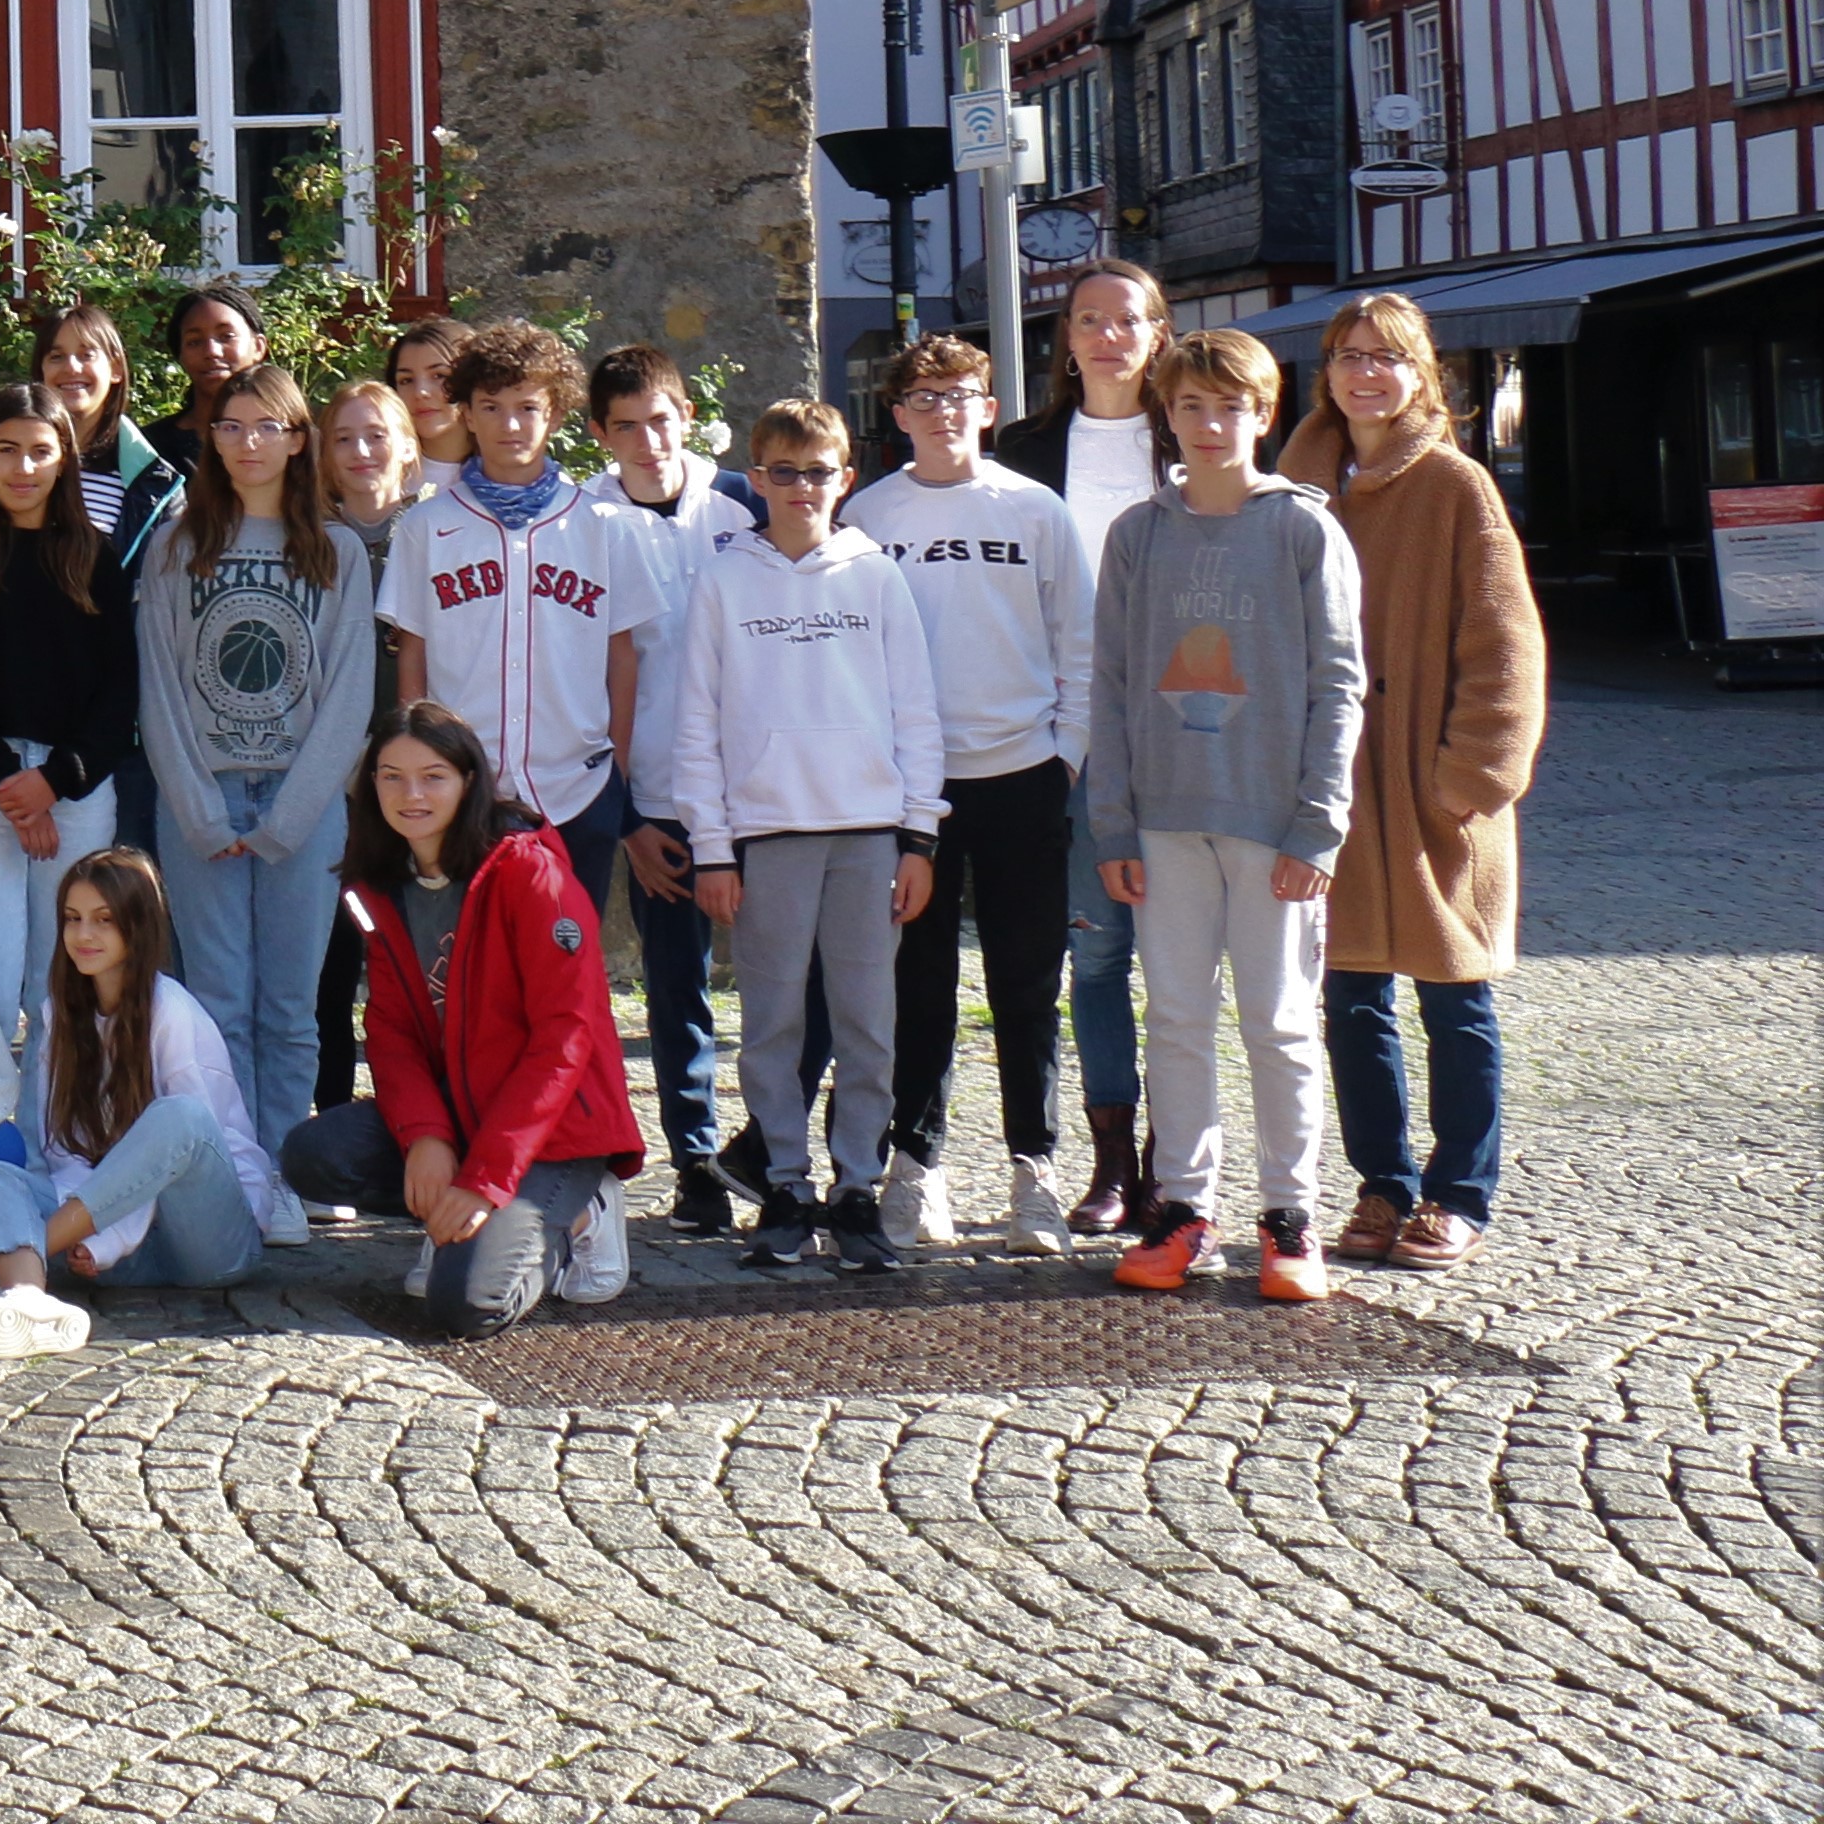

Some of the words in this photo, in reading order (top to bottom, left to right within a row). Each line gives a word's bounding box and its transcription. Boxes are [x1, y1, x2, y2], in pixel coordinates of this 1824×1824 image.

[431, 559, 505, 610] RED
[532, 562, 608, 618] SOX
[1172, 592, 1256, 622] WORLD
